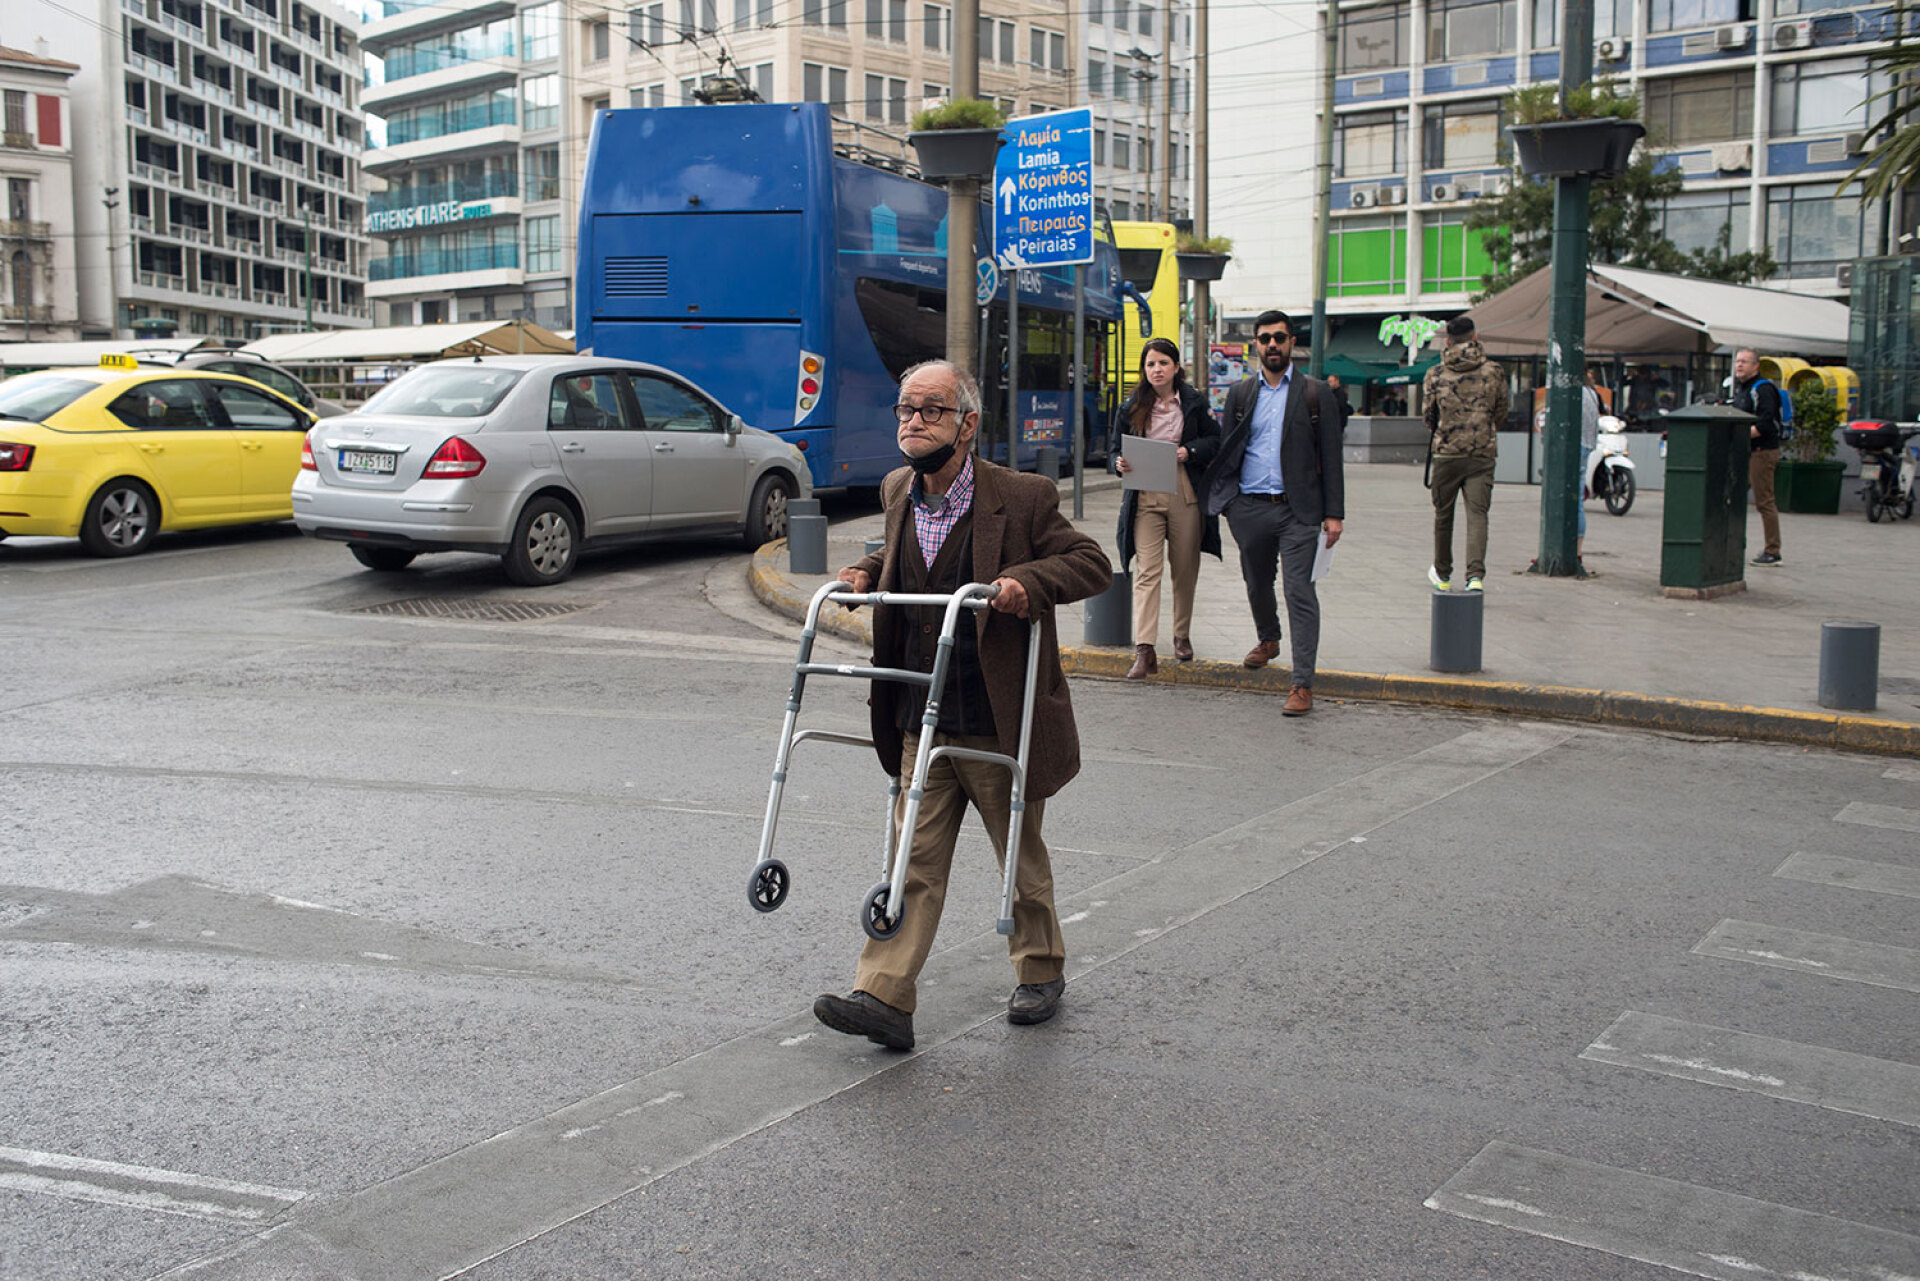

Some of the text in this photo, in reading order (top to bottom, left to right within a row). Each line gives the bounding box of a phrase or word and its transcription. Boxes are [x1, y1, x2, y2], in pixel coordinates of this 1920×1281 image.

[1017, 125, 1061, 148] Λαμία
[1018, 148, 1061, 169] Lamia
[1018, 169, 1088, 192] Κόρινθος
[1018, 191, 1090, 212] Korinthos
[366, 207, 416, 233] ATHENS
[1018, 211, 1086, 235] Πειραιάς
[1018, 236, 1077, 255] Peiraias
[101, 355, 126, 366] TAXI
[369, 454, 394, 469] 5118
